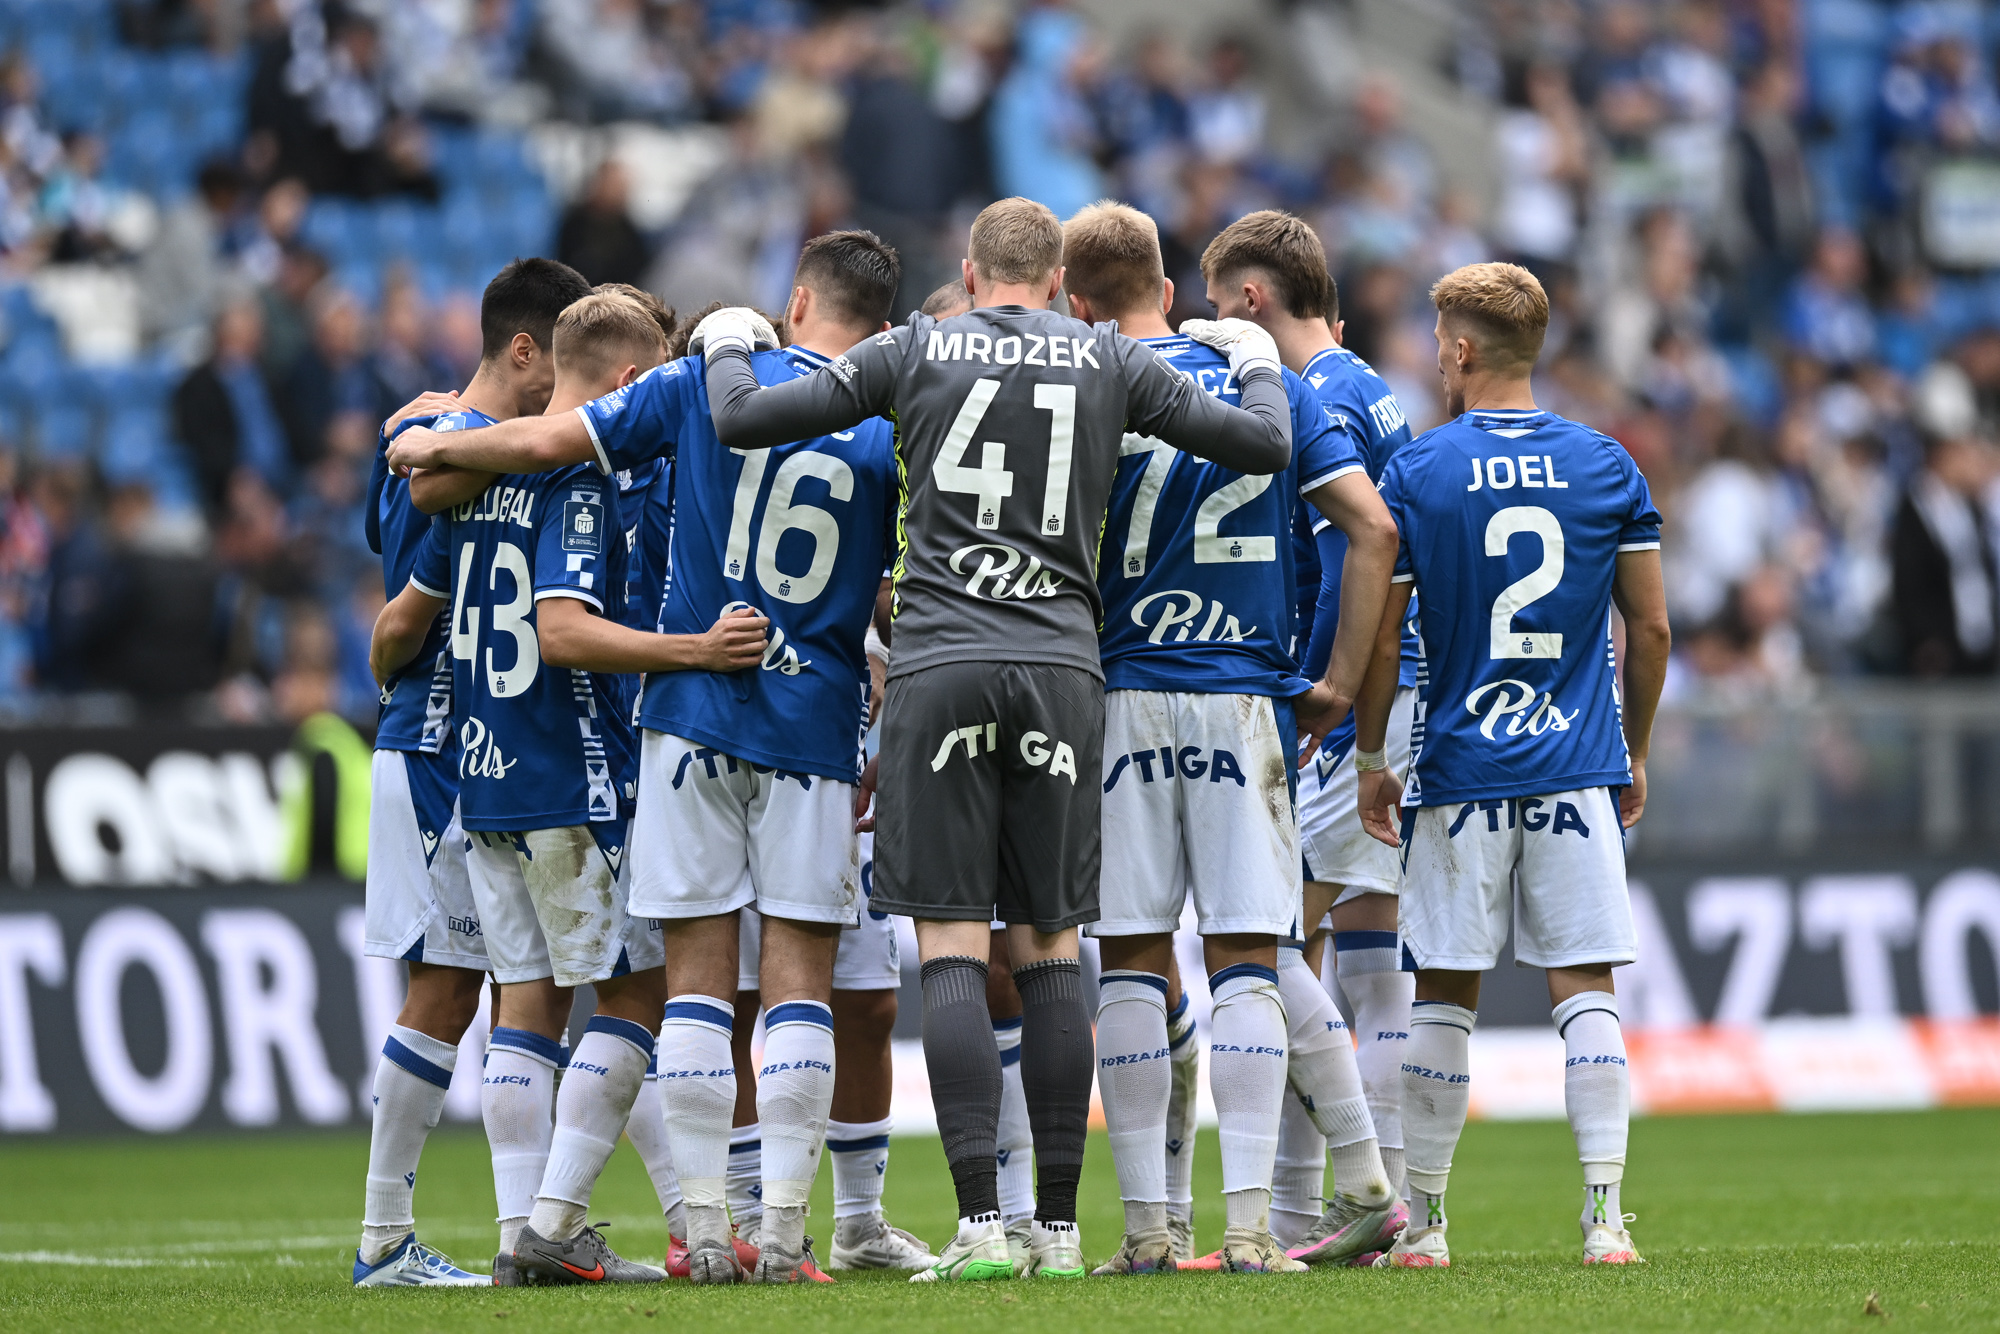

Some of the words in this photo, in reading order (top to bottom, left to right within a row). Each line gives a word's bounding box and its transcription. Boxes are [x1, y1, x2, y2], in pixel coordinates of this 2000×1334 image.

[926, 330, 1100, 369] MROZEK
[932, 378, 1076, 535] 41
[1467, 455, 1569, 492] JOEL
[723, 447, 855, 604] 16
[1119, 431, 1276, 578] 72
[949, 543, 1065, 599] Pils
[1485, 506, 1564, 660] 2
[452, 542, 540, 698] 43
[719, 600, 812, 676] ls
[1130, 589, 1257, 645] Pils
[1465, 679, 1579, 741] Pils
[460, 716, 517, 779] Pils
[1103, 746, 1246, 793] STIGA
[1449, 798, 1589, 839] STIGA
[1326, 1021, 1348, 1031] FOR
[1101, 1052, 1150, 1068] FORZA
[1401, 1063, 1446, 1081] FORZA
